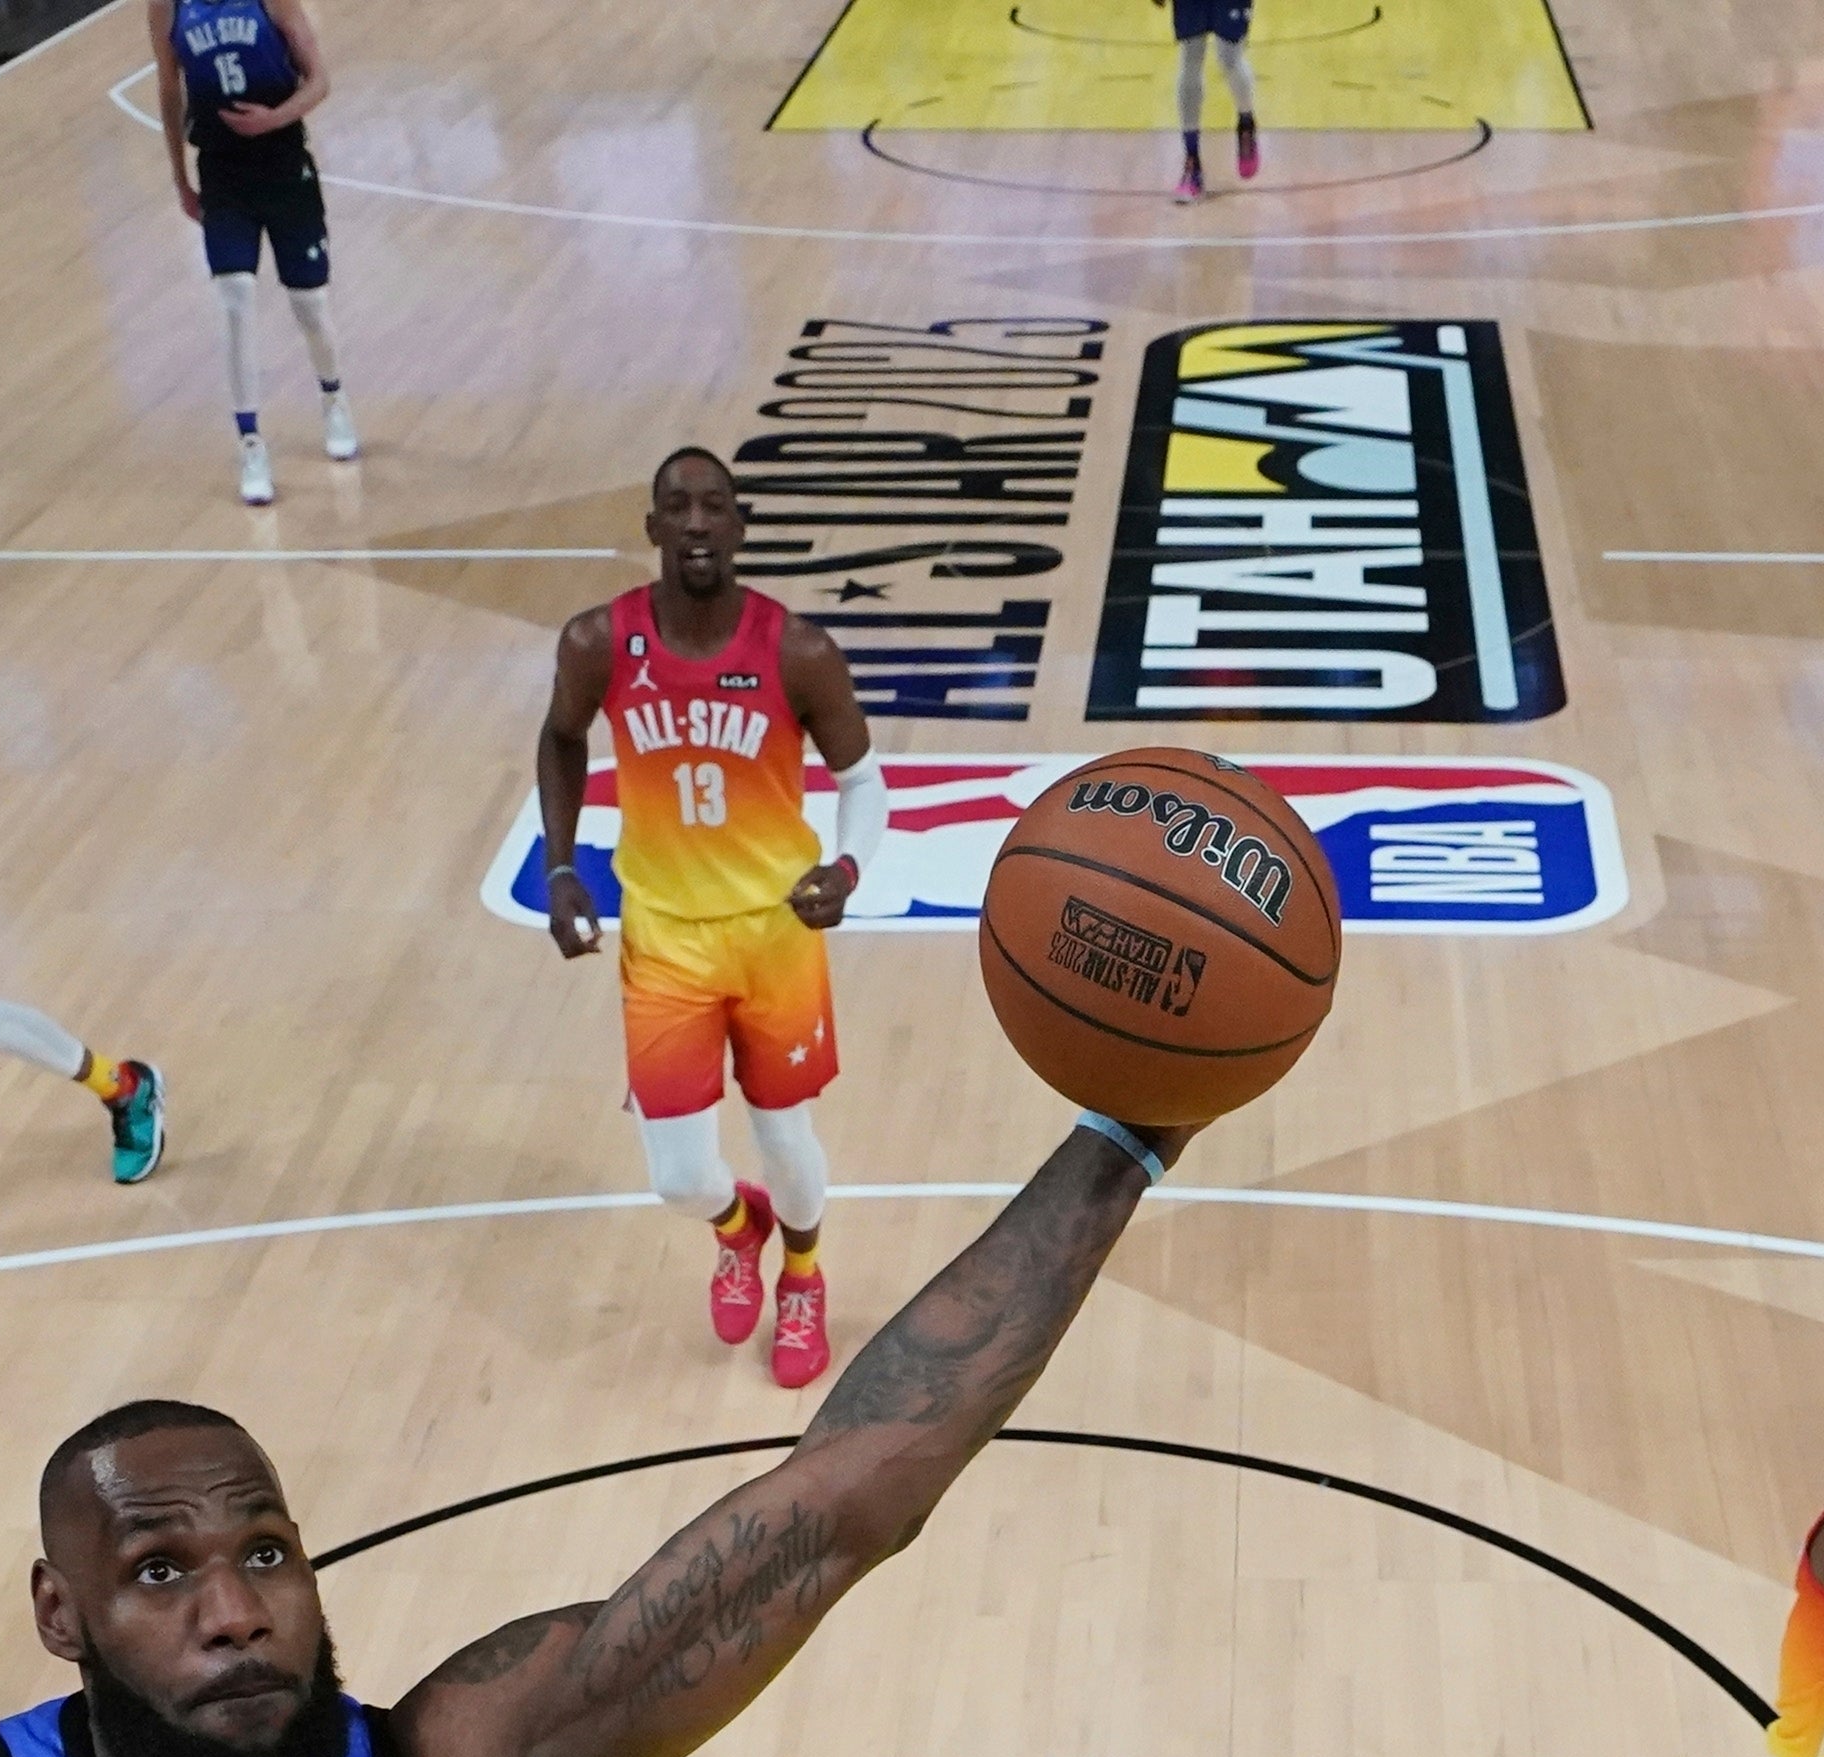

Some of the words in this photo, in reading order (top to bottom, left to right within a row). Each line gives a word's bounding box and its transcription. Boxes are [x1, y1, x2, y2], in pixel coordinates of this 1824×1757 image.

[214, 51, 247, 95] 15
[1135, 498, 1437, 709] UTAH
[673, 762, 727, 827] 13
[1066, 780, 1294, 928] Wilson
[1368, 819, 1545, 904] NBA
[1111, 929, 1168, 973] UTAH
